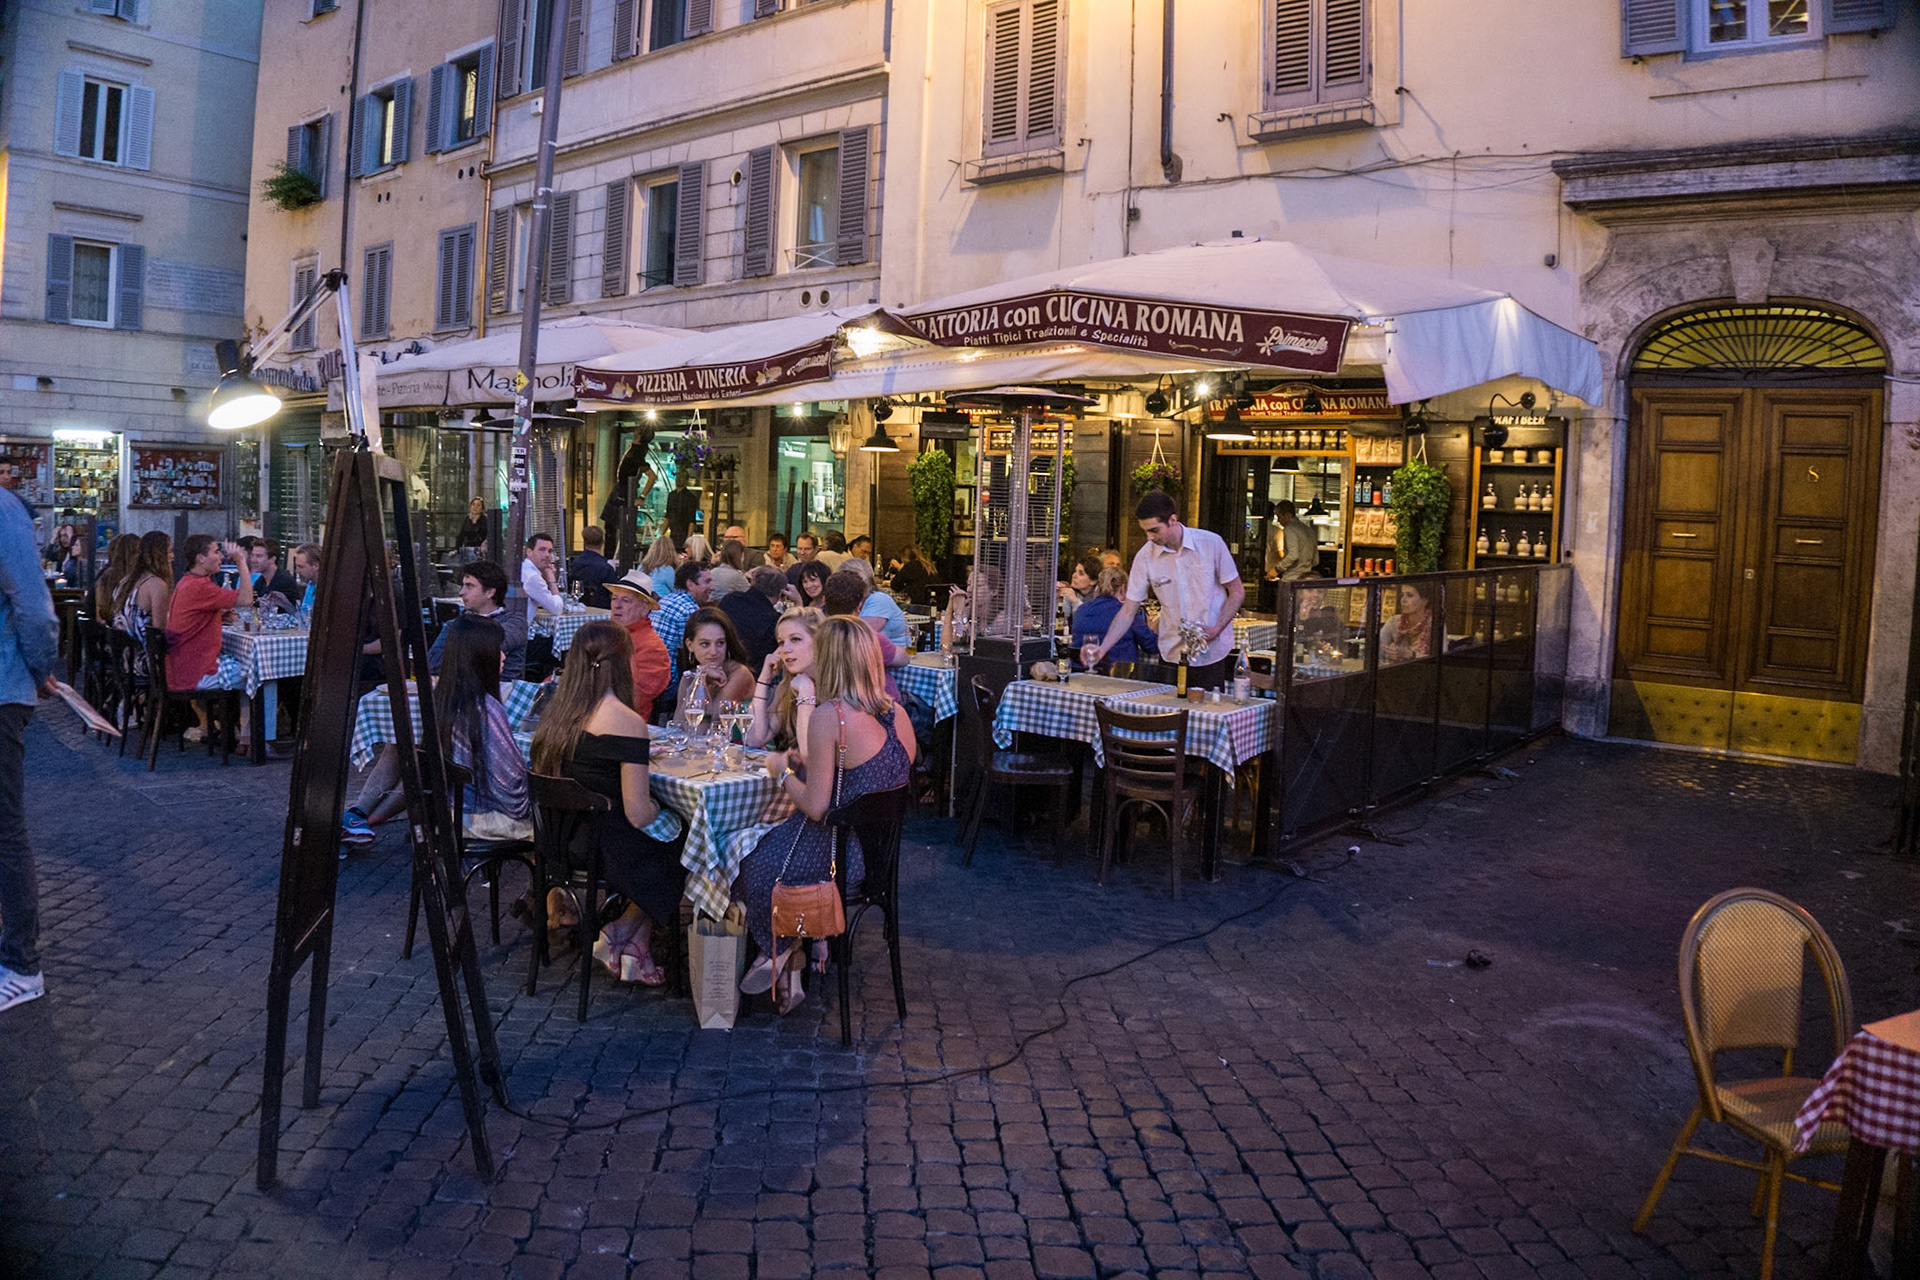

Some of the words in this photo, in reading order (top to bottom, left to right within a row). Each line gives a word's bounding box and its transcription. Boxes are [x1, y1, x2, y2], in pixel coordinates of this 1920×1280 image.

[1003, 306, 1041, 327] con
[1046, 296, 1129, 330] CUCINA
[1134, 304, 1245, 343] ROMANA
[963, 334, 990, 346] Piatti
[993, 332, 1022, 346] Tipici
[1091, 329, 1149, 347] Specialità
[635, 374, 688, 393] PIZZERIA
[695, 365, 750, 389] VINERIA
[661, 394, 681, 403] Liguori
[682, 391, 710, 401] Nazionali
[711, 390, 720, 399] ed
[1269, 400, 1291, 411] con
[1340, 397, 1395, 410] ROMANA
[1520, 415, 1546, 426] BEER
